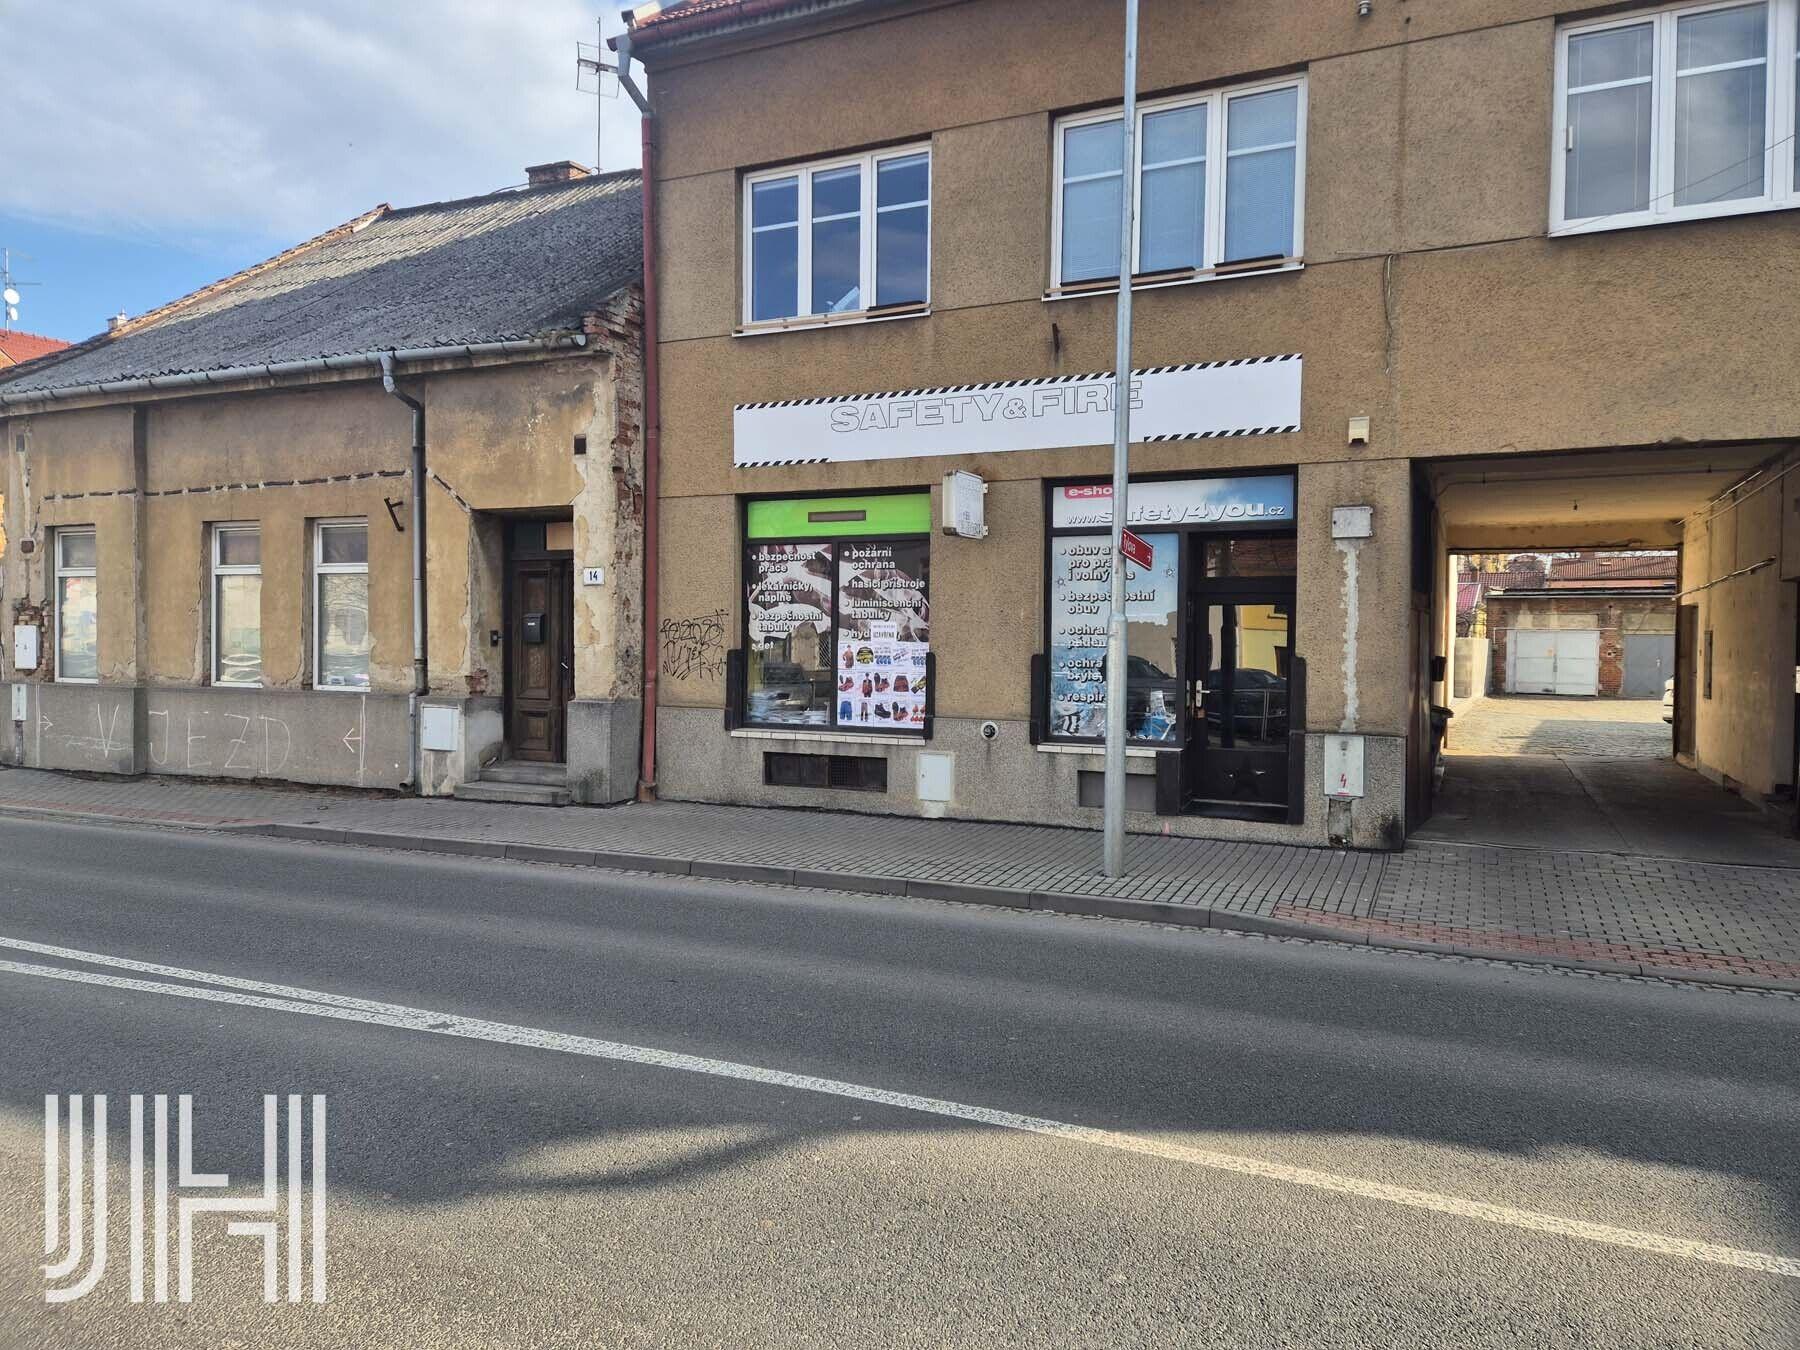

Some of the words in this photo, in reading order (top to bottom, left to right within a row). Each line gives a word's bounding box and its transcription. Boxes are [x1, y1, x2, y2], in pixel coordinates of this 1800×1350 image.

[1068, 486, 1113, 497] e-sho
[1069, 546, 1098, 555] obuv
[758, 564, 787, 573] práce
[852, 560, 895, 570] ochrana
[1069, 560, 1091, 568] pro
[589, 571, 598, 581] 14
[1075, 569, 1110, 582] volný
[1068, 605, 1099, 614] obuv
[852, 611, 891, 621] tabulky
[1067, 624, 1107, 635] ochra
[1067, 658, 1103, 668] ochra
[1067, 692, 1106, 704] respir
